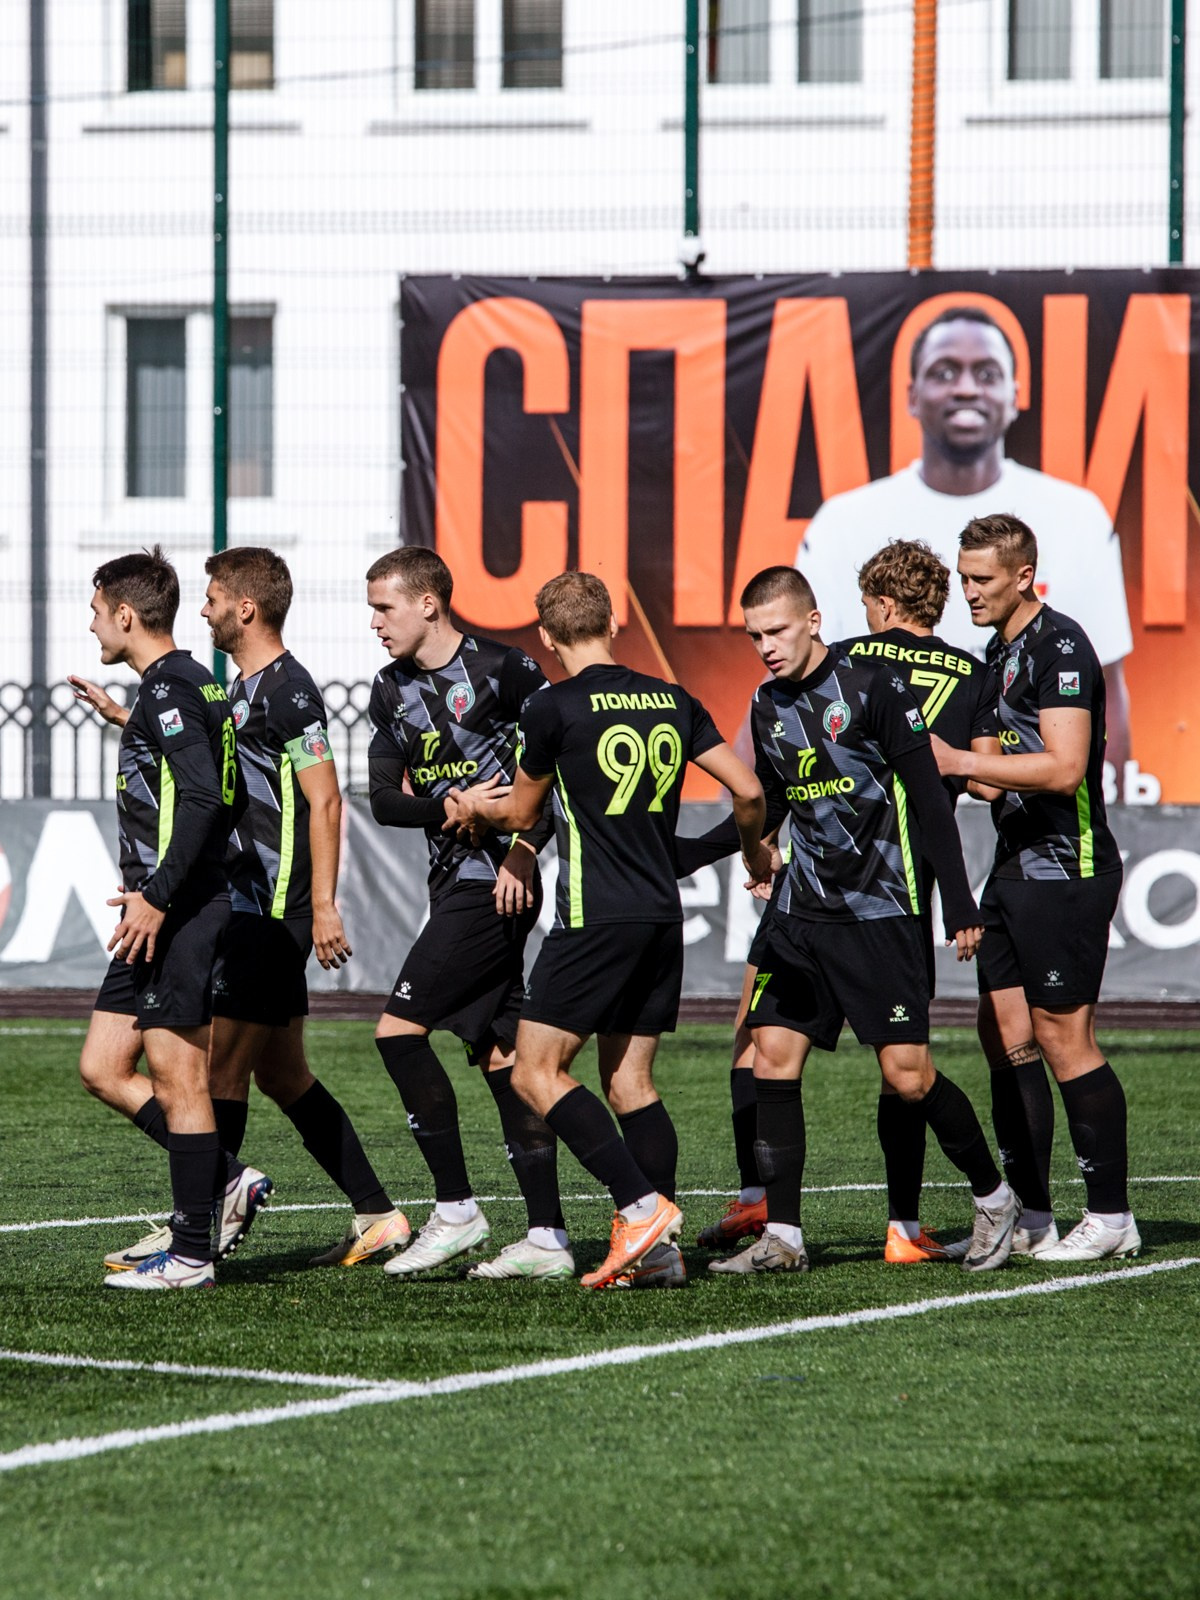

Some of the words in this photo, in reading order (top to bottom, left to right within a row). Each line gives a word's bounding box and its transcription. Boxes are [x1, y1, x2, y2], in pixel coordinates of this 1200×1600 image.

[849, 642, 972, 676] АЛЕКСЕЕВ
[589, 692, 677, 712] ЛОМАШ
[910, 669, 959, 729] 7
[597, 723, 682, 815] 99
